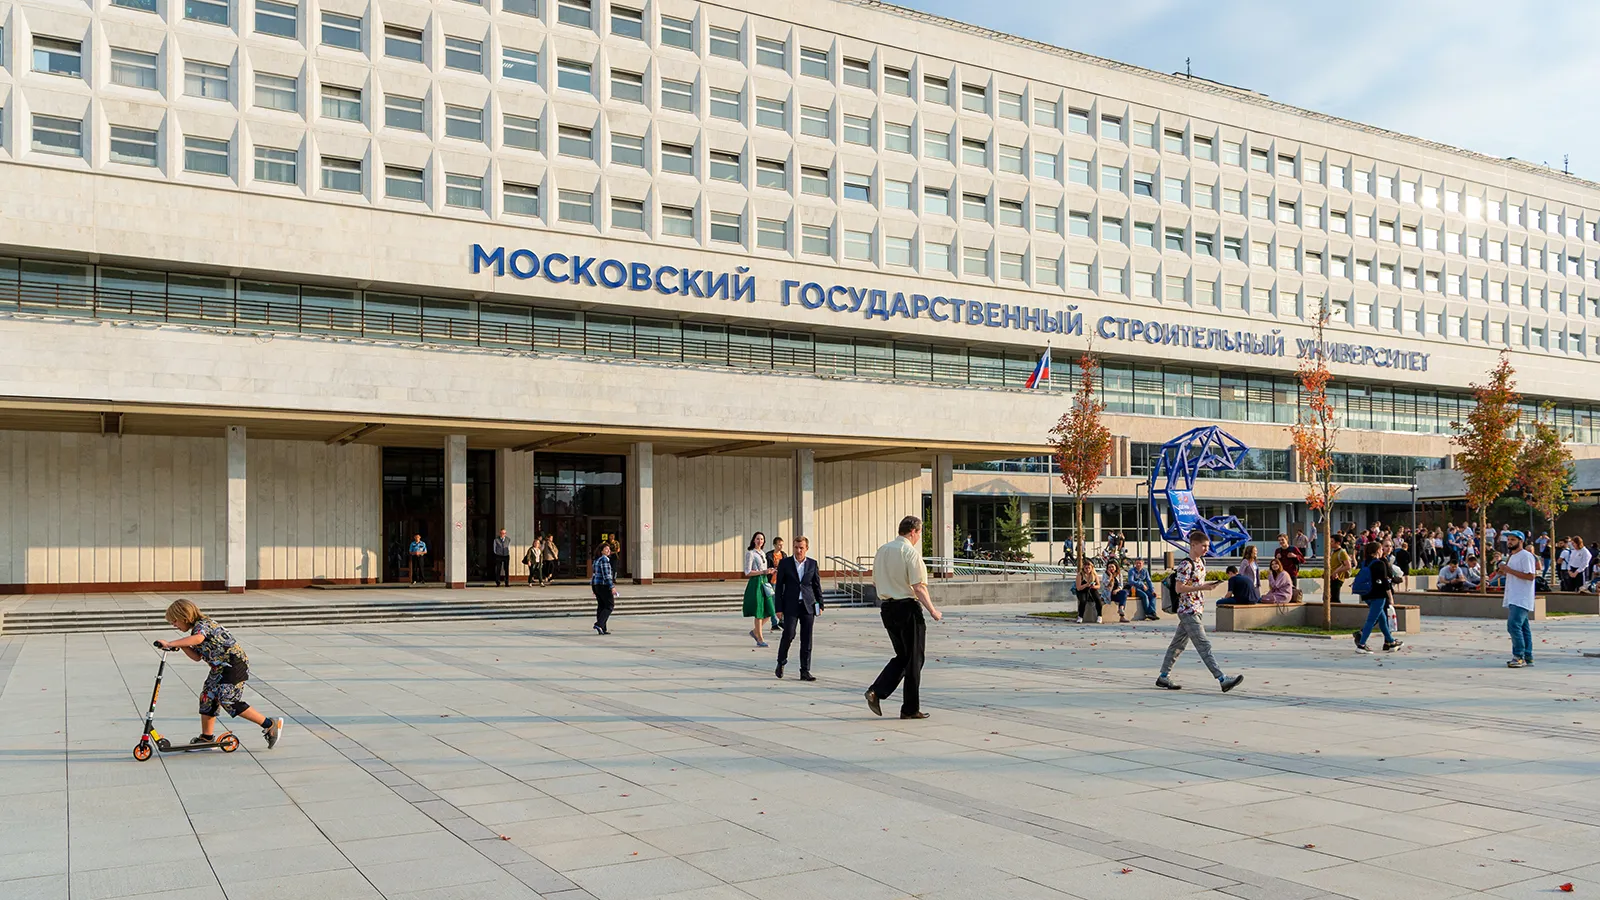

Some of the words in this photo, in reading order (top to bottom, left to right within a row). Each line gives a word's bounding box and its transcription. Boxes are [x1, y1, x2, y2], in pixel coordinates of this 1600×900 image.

[472, 243, 755, 302] МОСКОВСКИЙ
[781, 280, 1083, 336] ГОСУДАРСТВЕННЫЙ
[1097, 315, 1285, 357] СТРОИТЕЛЬНЫЙ
[1296, 338, 1431, 372] УНИВЕРСИТЕТ
